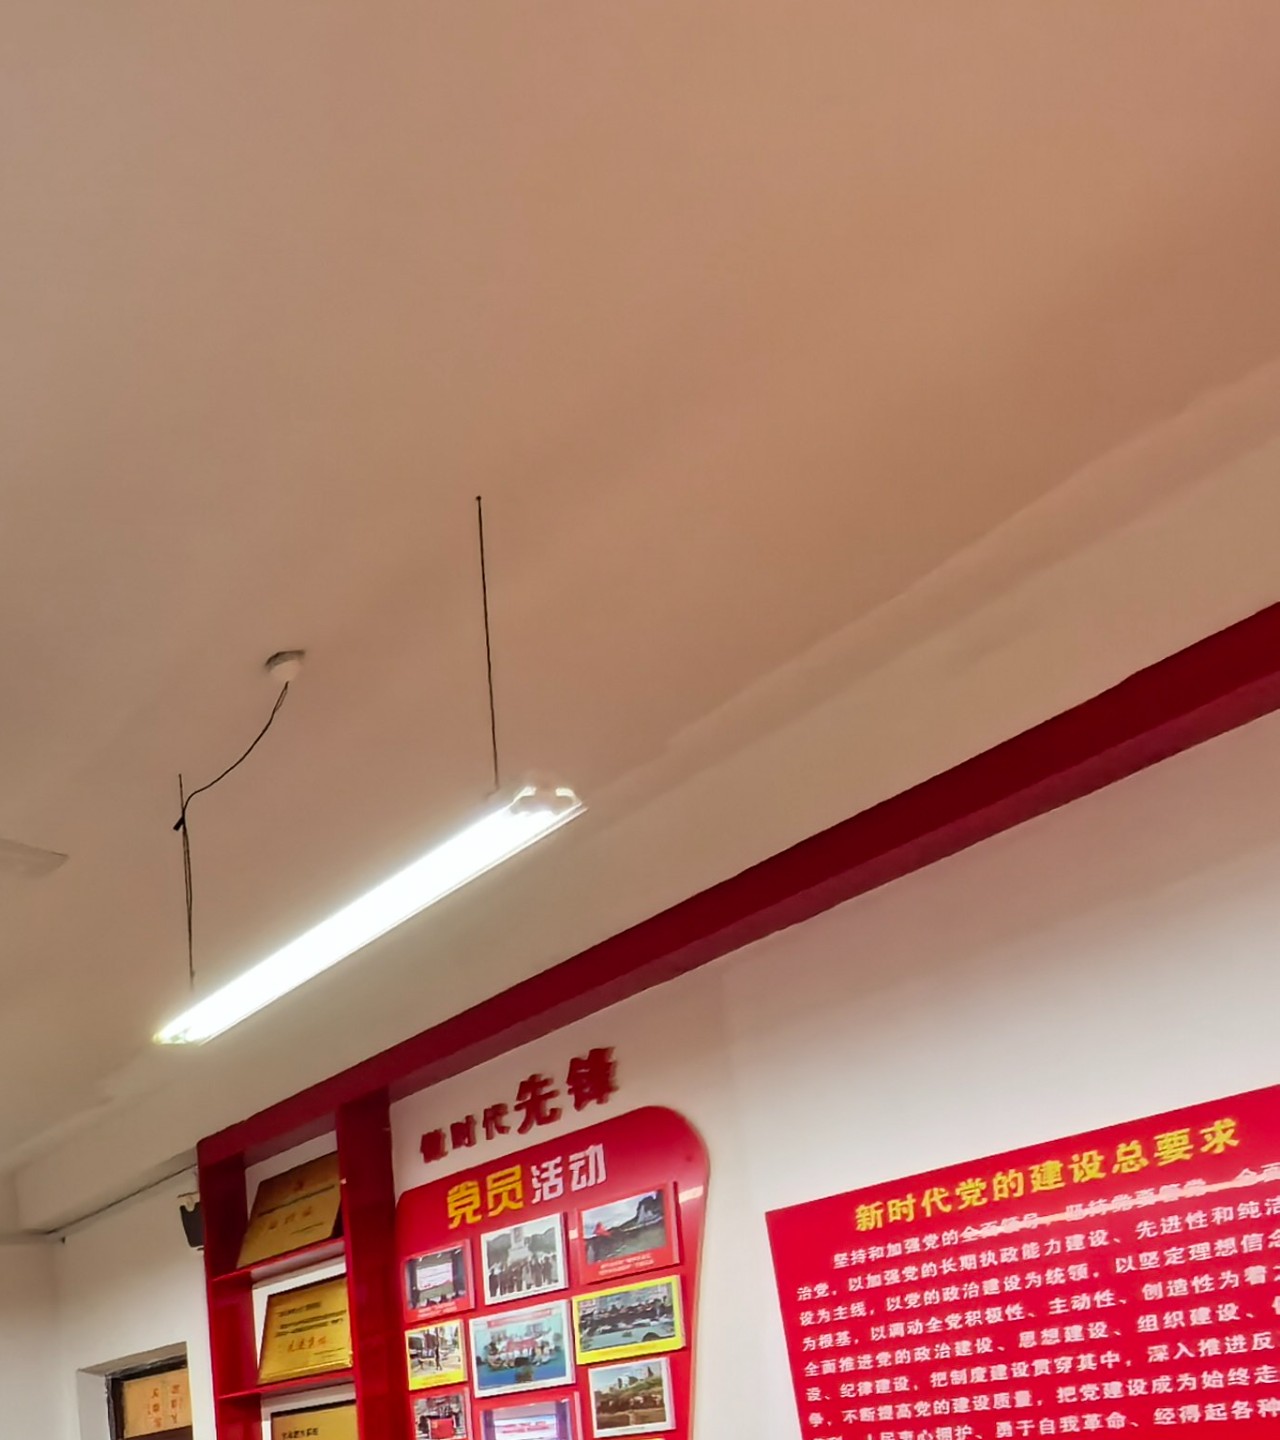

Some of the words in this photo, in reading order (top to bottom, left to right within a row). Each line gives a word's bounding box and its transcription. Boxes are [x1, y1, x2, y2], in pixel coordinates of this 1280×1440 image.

[446, 1142, 607, 1229] 党员活动
[854, 1117, 1240, 1232] 新时代党的建设总要求
[802, 1264, 1280, 1352] 为根基，以调动全党积极性、主动性、创造性为着
